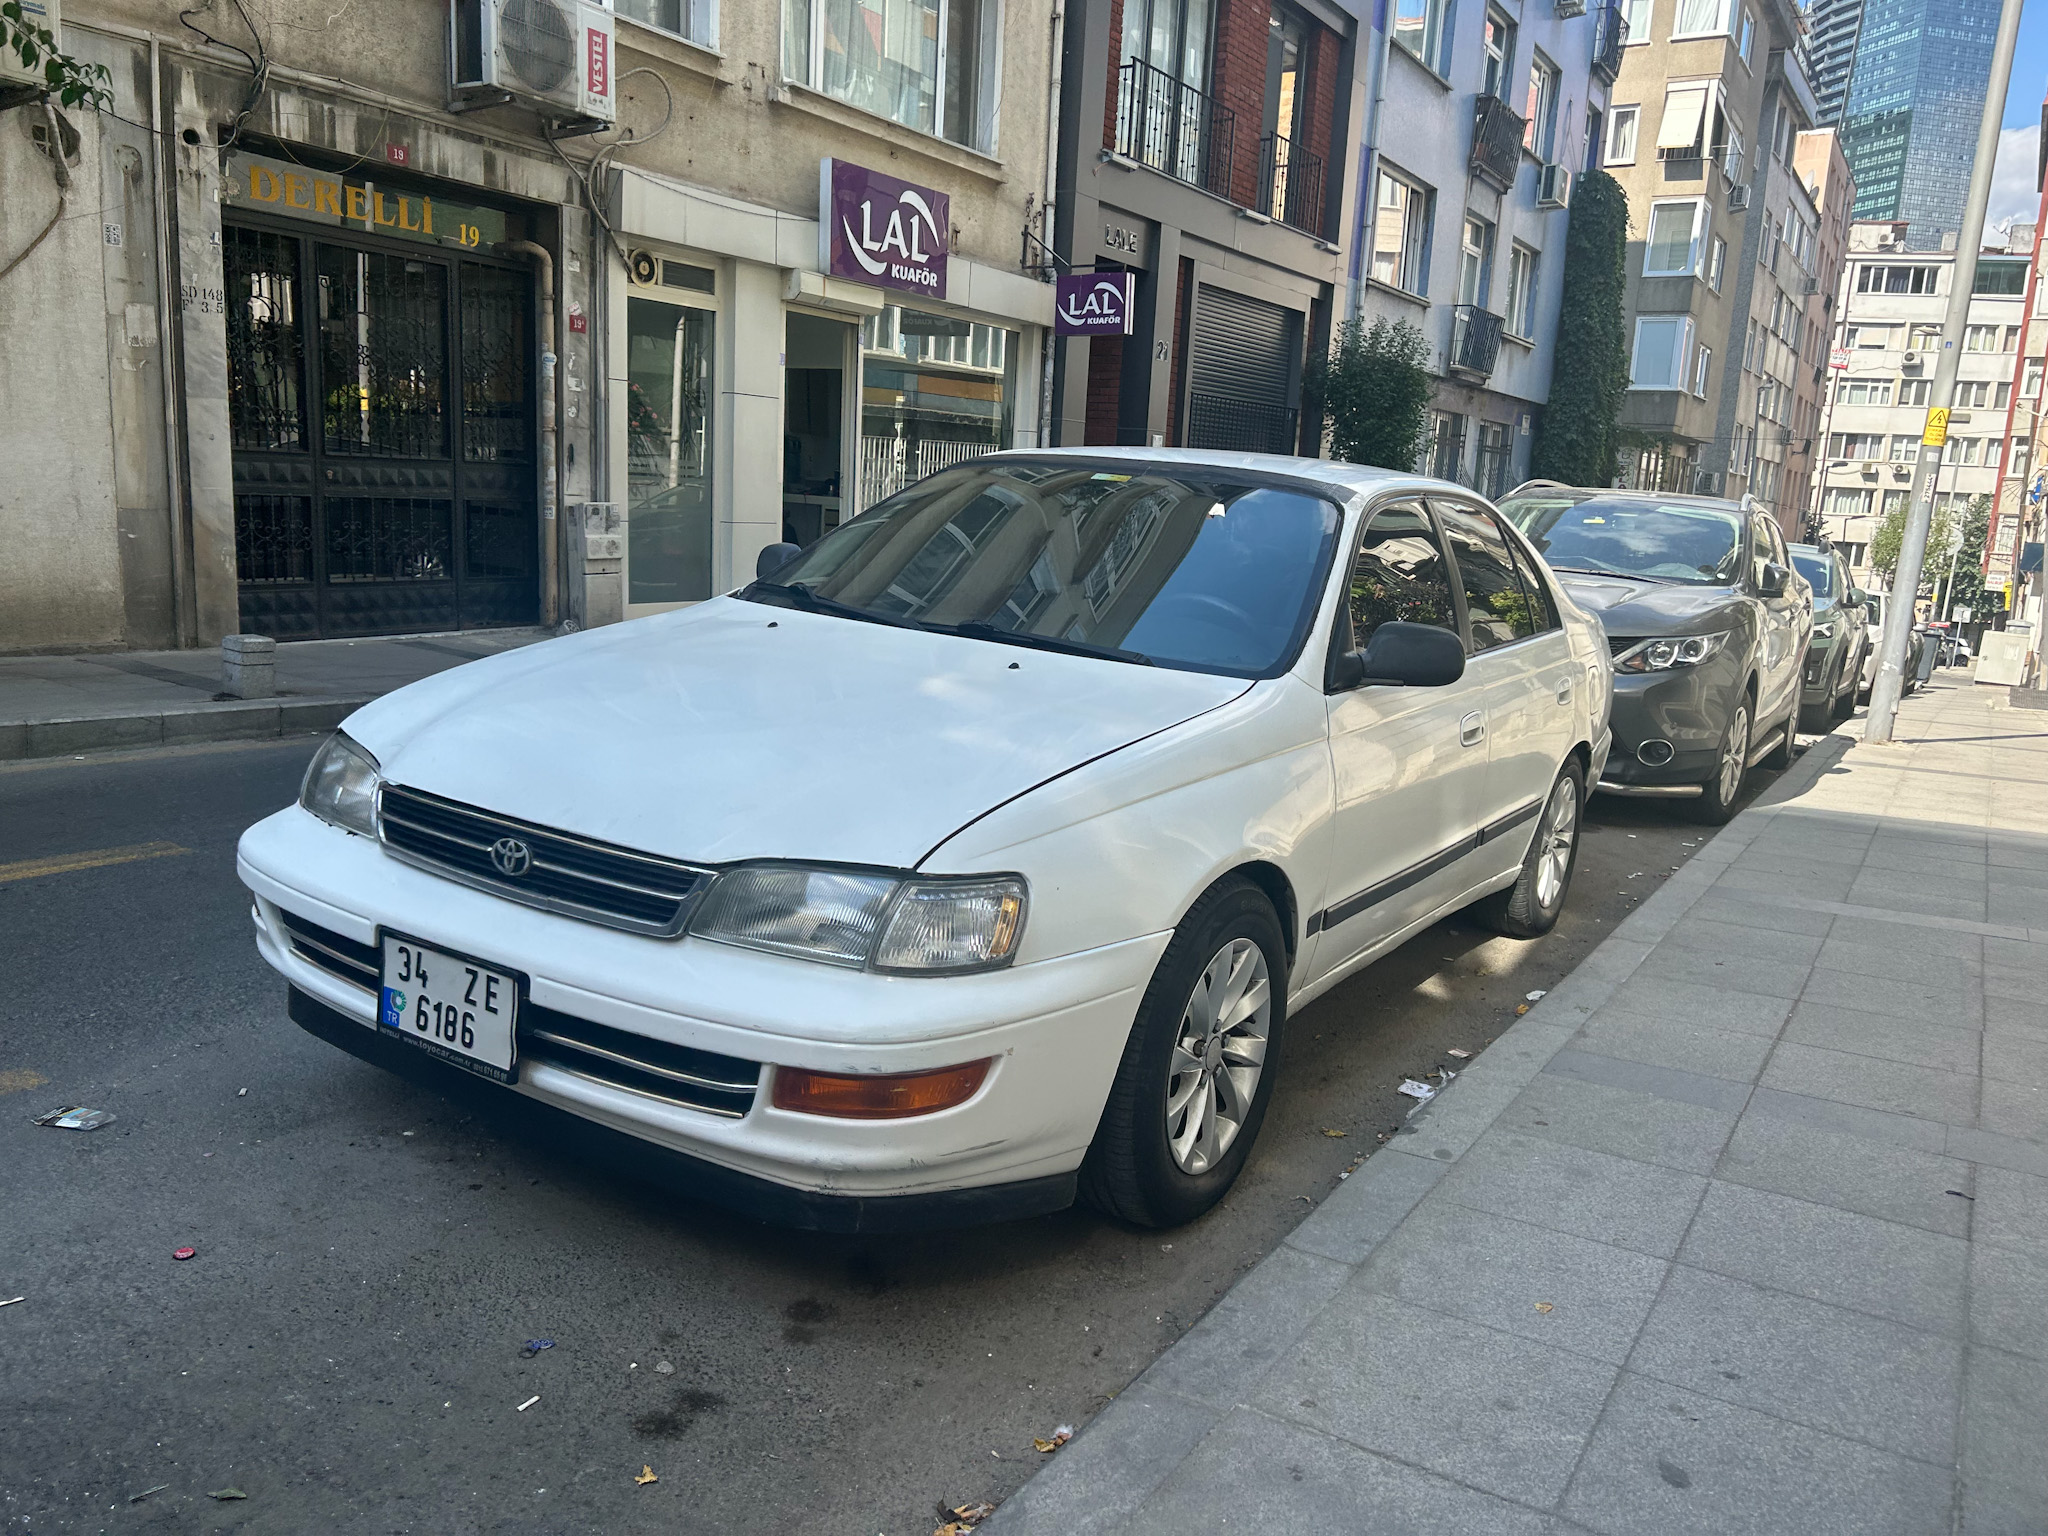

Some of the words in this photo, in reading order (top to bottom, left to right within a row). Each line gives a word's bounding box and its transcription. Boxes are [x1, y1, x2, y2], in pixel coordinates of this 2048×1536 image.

[592, 34, 603, 93] VESTEL
[249, 164, 434, 235] DERELLİ
[459, 223, 480, 248] 19
[861, 200, 930, 264] LAL
[1105, 223, 1138, 255] LALE
[891, 263, 938, 288] KUAFÖR
[181, 285, 197, 299] SD
[202, 289, 223, 302] 148
[1068, 291, 1116, 315] LAL
[1087, 315, 1121, 325] KUAFÖR
[1157, 339, 1169, 363] 21
[398, 946, 428, 988] 34
[464, 967, 500, 1016] ZE
[387, 1010, 398, 1025] TR
[416, 994, 475, 1049] 6186
[403, 1035, 471, 1067] www.toyocar.com.tr
